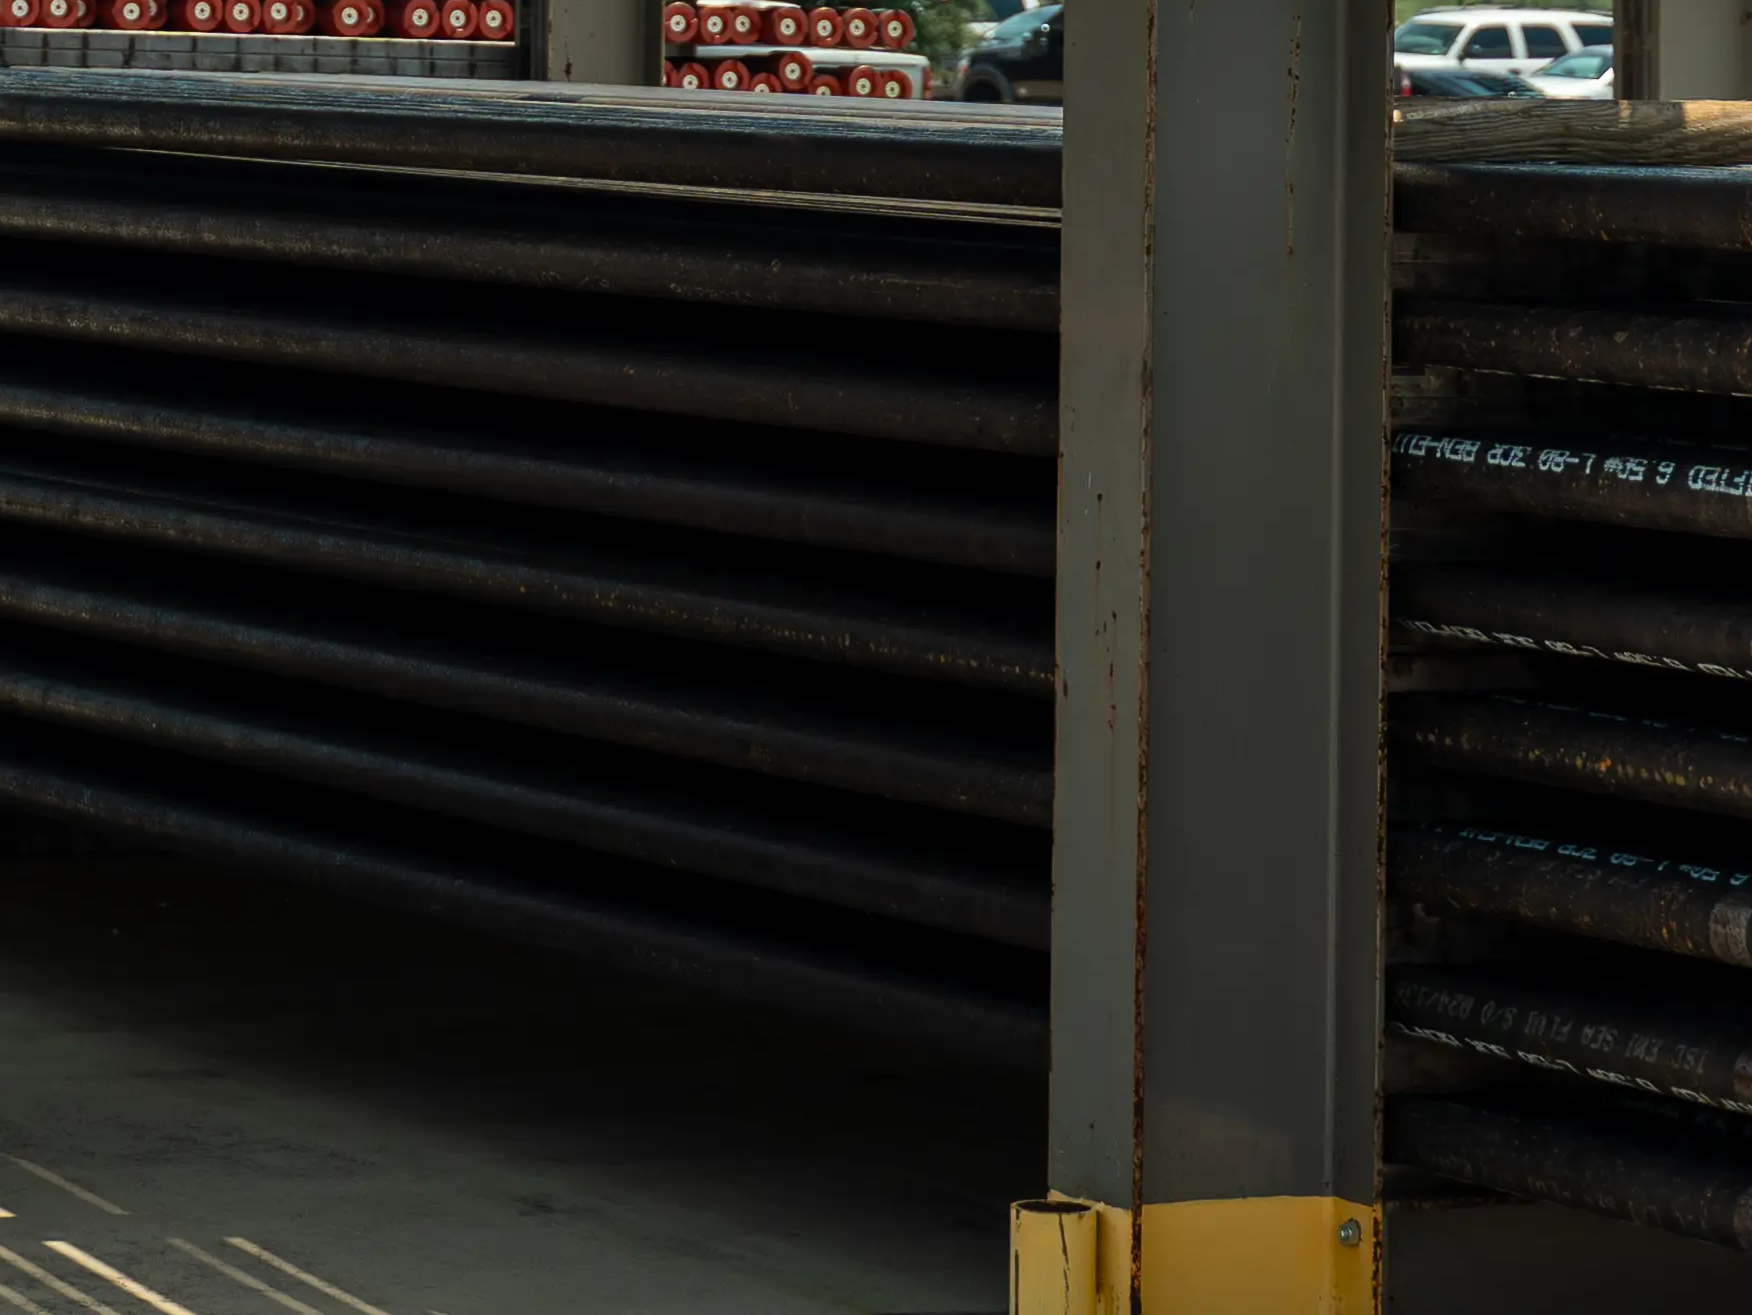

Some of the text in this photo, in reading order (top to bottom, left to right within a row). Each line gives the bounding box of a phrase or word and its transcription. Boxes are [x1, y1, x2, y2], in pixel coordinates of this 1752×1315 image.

[1487, 443, 1532, 467] 3CR
[1537, 448, 1596, 475] L-80
[1603, 457, 1676, 484] 6.50#
